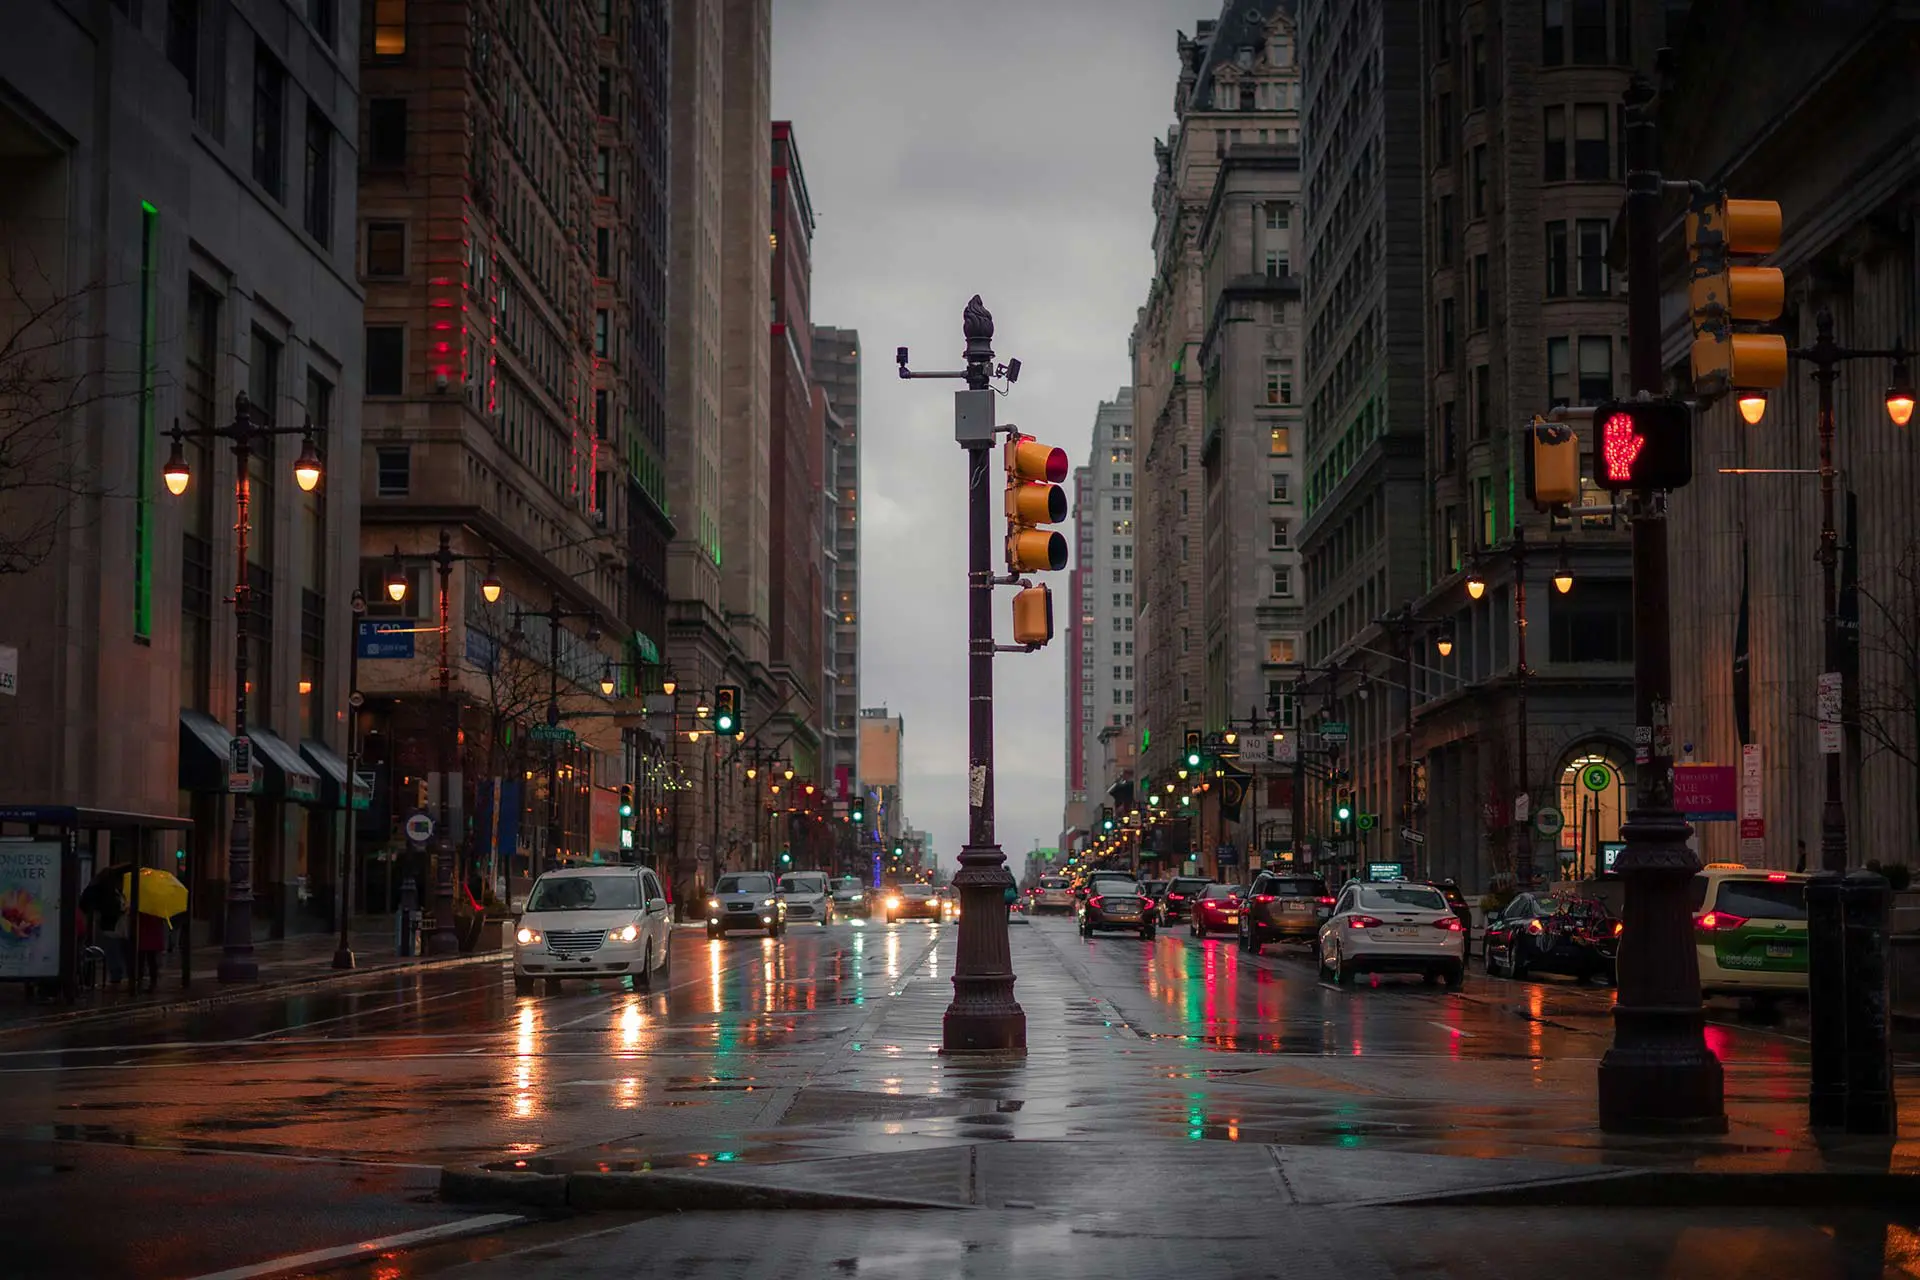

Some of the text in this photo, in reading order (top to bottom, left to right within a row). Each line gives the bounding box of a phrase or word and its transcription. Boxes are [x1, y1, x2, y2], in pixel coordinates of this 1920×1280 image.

[1246, 739, 1261, 749] NO
[1241, 751, 1267, 760] TURNS
[1685, 794, 1713, 805] ARTS
